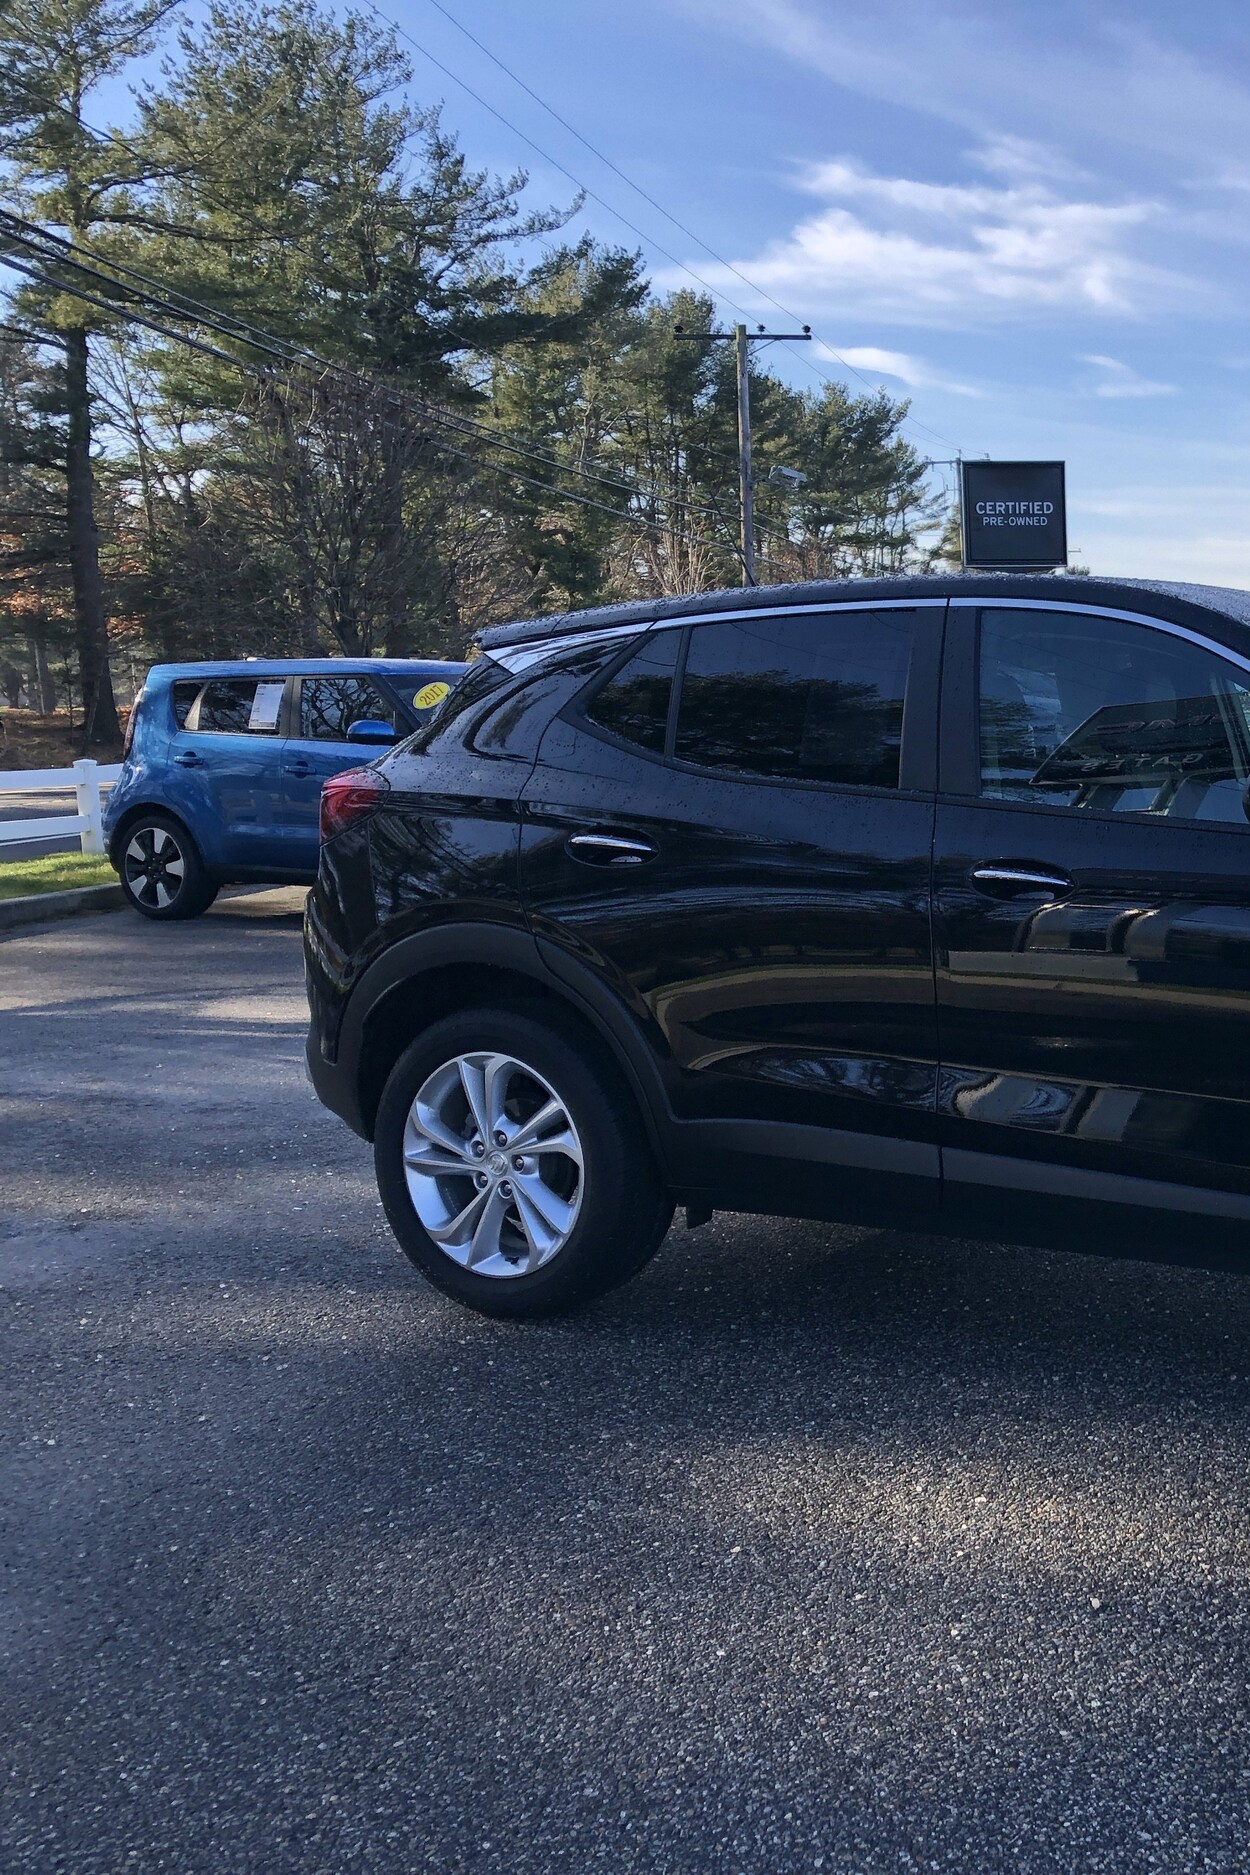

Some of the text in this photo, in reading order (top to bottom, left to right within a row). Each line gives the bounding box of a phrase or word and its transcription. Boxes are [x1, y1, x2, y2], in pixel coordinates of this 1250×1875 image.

[975, 502, 1054, 514] CERTIFIED
[982, 516, 1048, 526] PRE-OWNED
[419, 684, 444, 706] 2017
